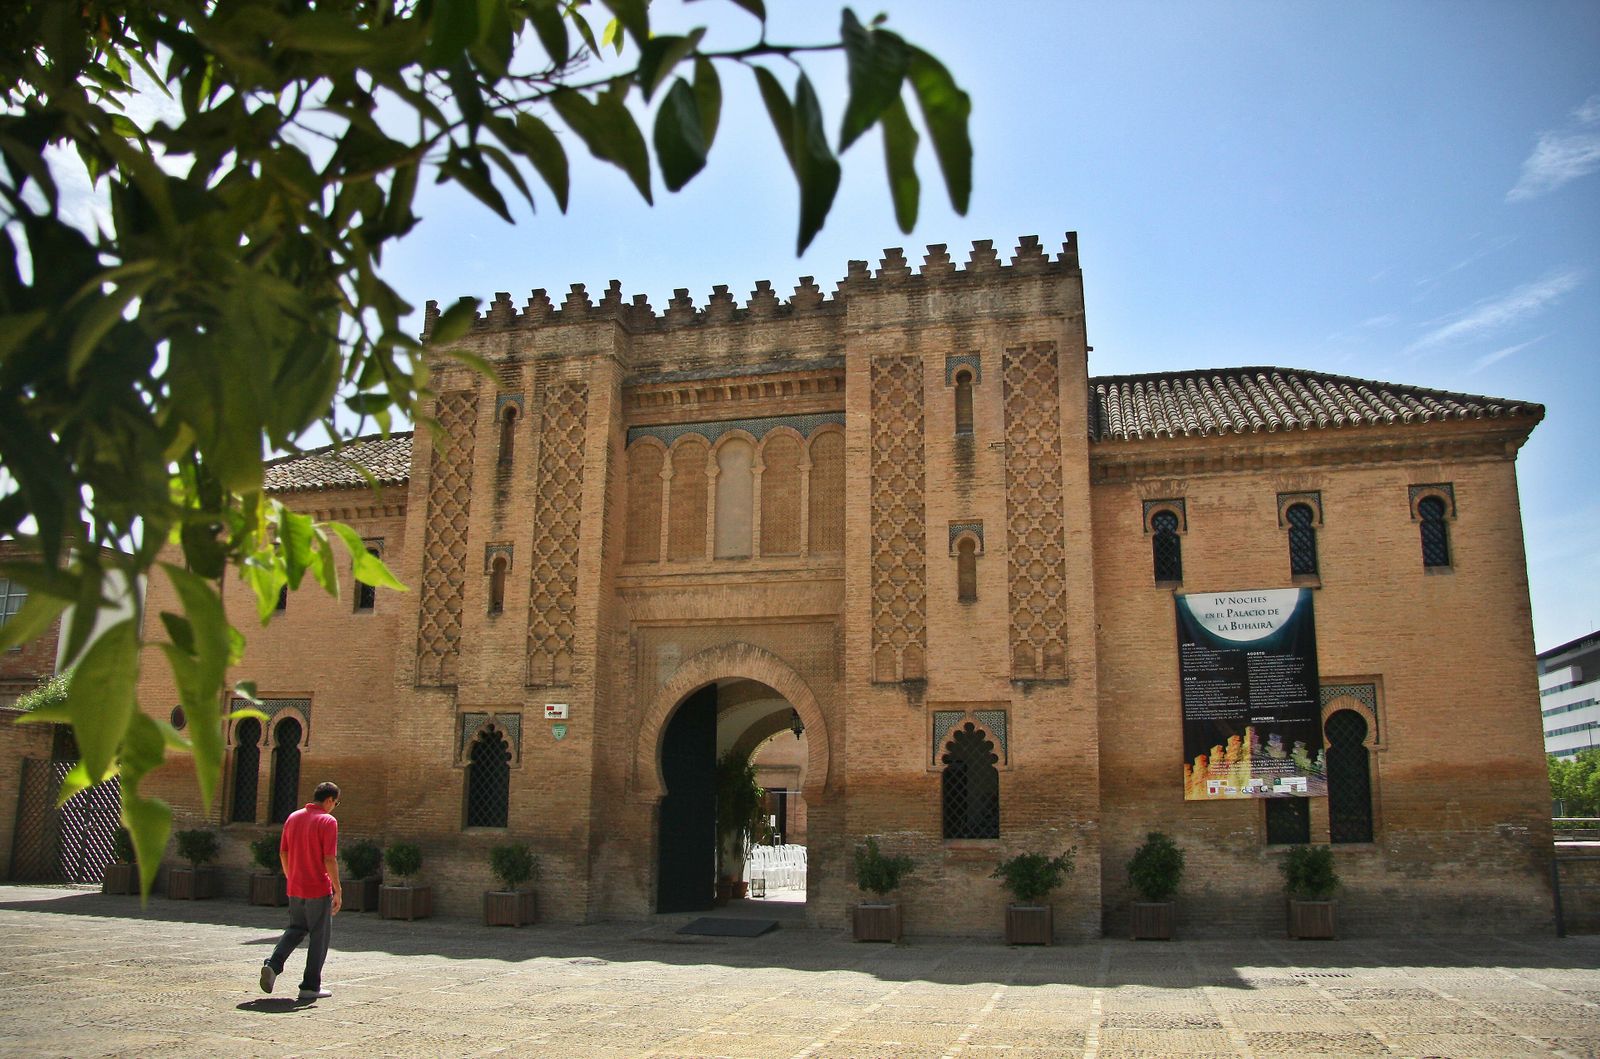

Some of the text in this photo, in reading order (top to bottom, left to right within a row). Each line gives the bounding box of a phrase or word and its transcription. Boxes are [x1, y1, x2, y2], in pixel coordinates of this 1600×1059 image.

[1215, 596, 1267, 605] IV NOCHES
[1226, 608, 1265, 618] PALACIO
[1267, 608, 1280, 616] DE
[1230, 621, 1273, 630] BUHAIRA
